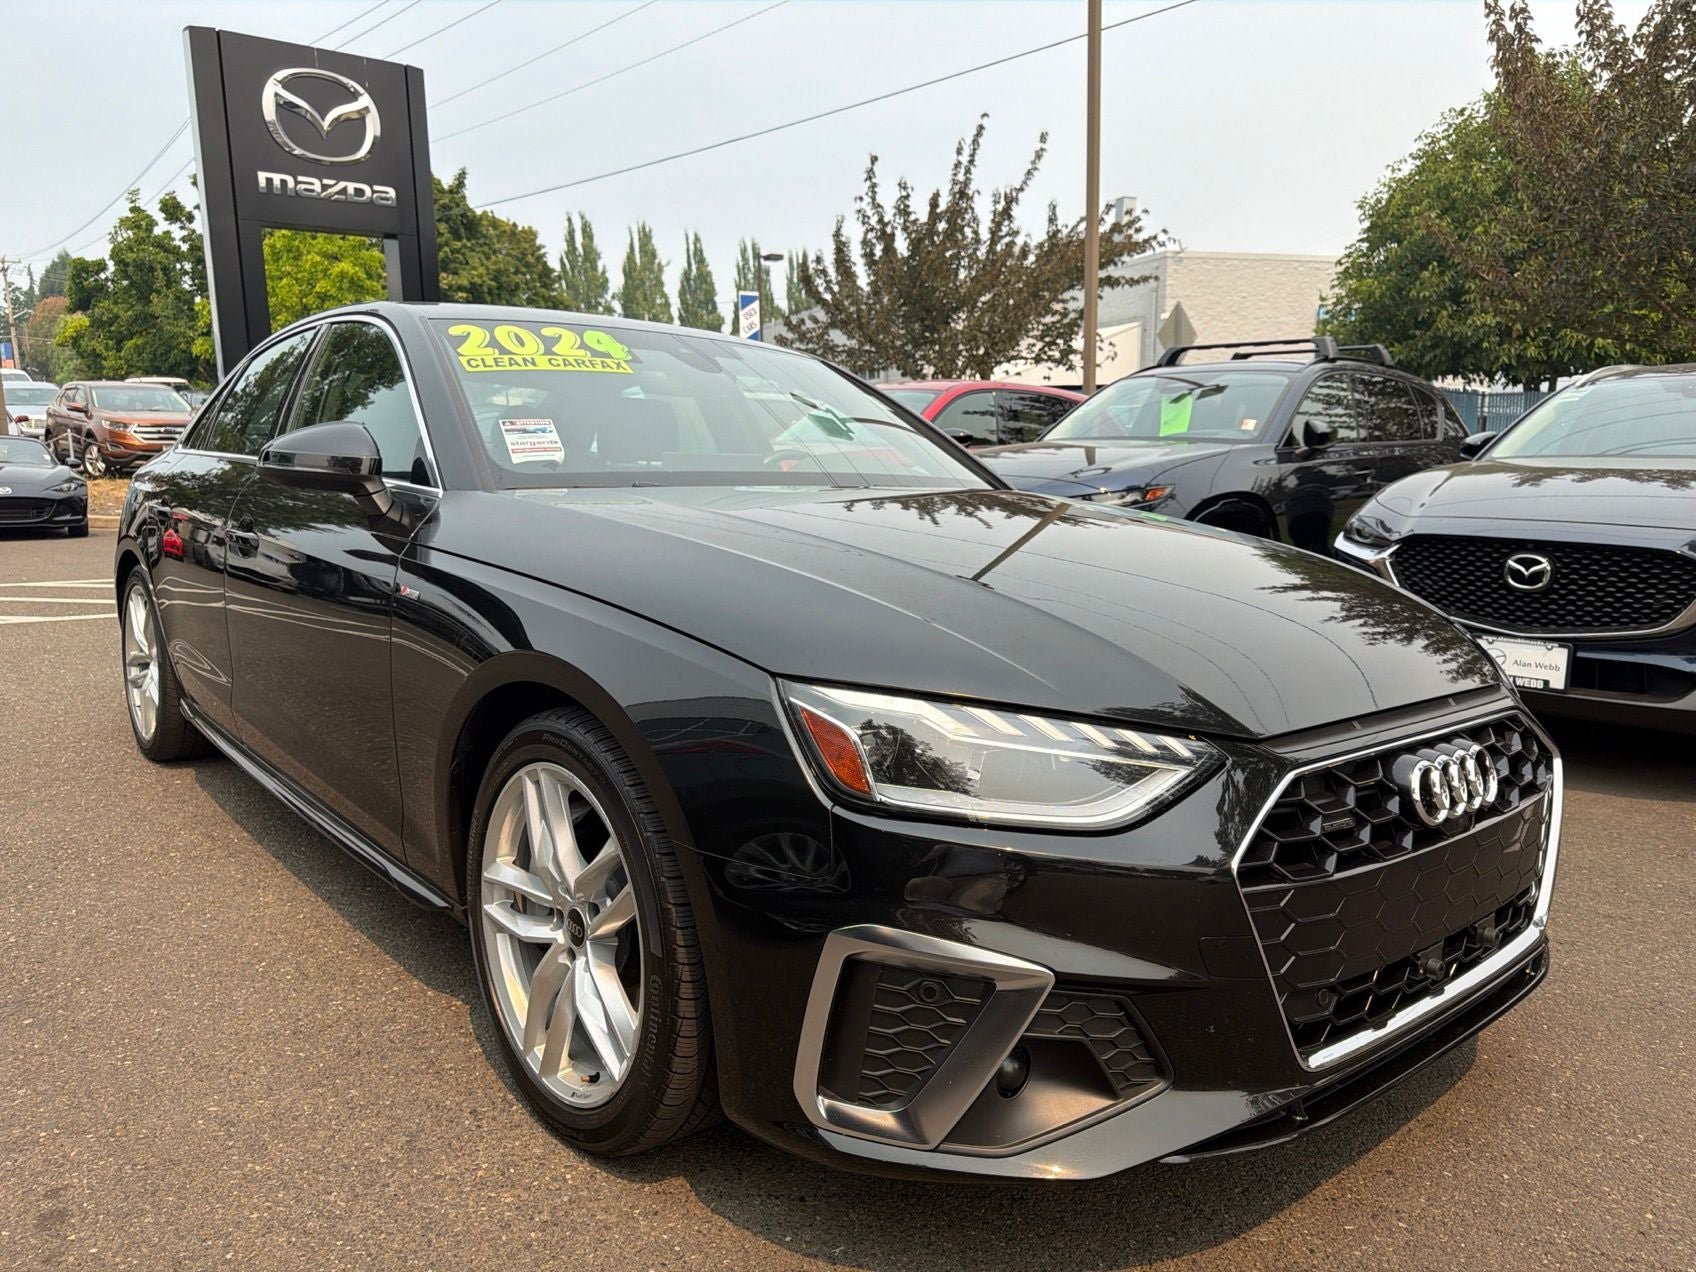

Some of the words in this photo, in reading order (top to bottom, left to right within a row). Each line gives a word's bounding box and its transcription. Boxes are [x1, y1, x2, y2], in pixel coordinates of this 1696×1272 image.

[448, 325, 632, 361] 2024
[466, 357, 538, 369] CLEAN
[548, 357, 629, 371] CARFAX
[1512, 659, 1532, 669] Alan
[1534, 661, 1560, 672] Webb
[1516, 677, 1544, 689] WEBB
